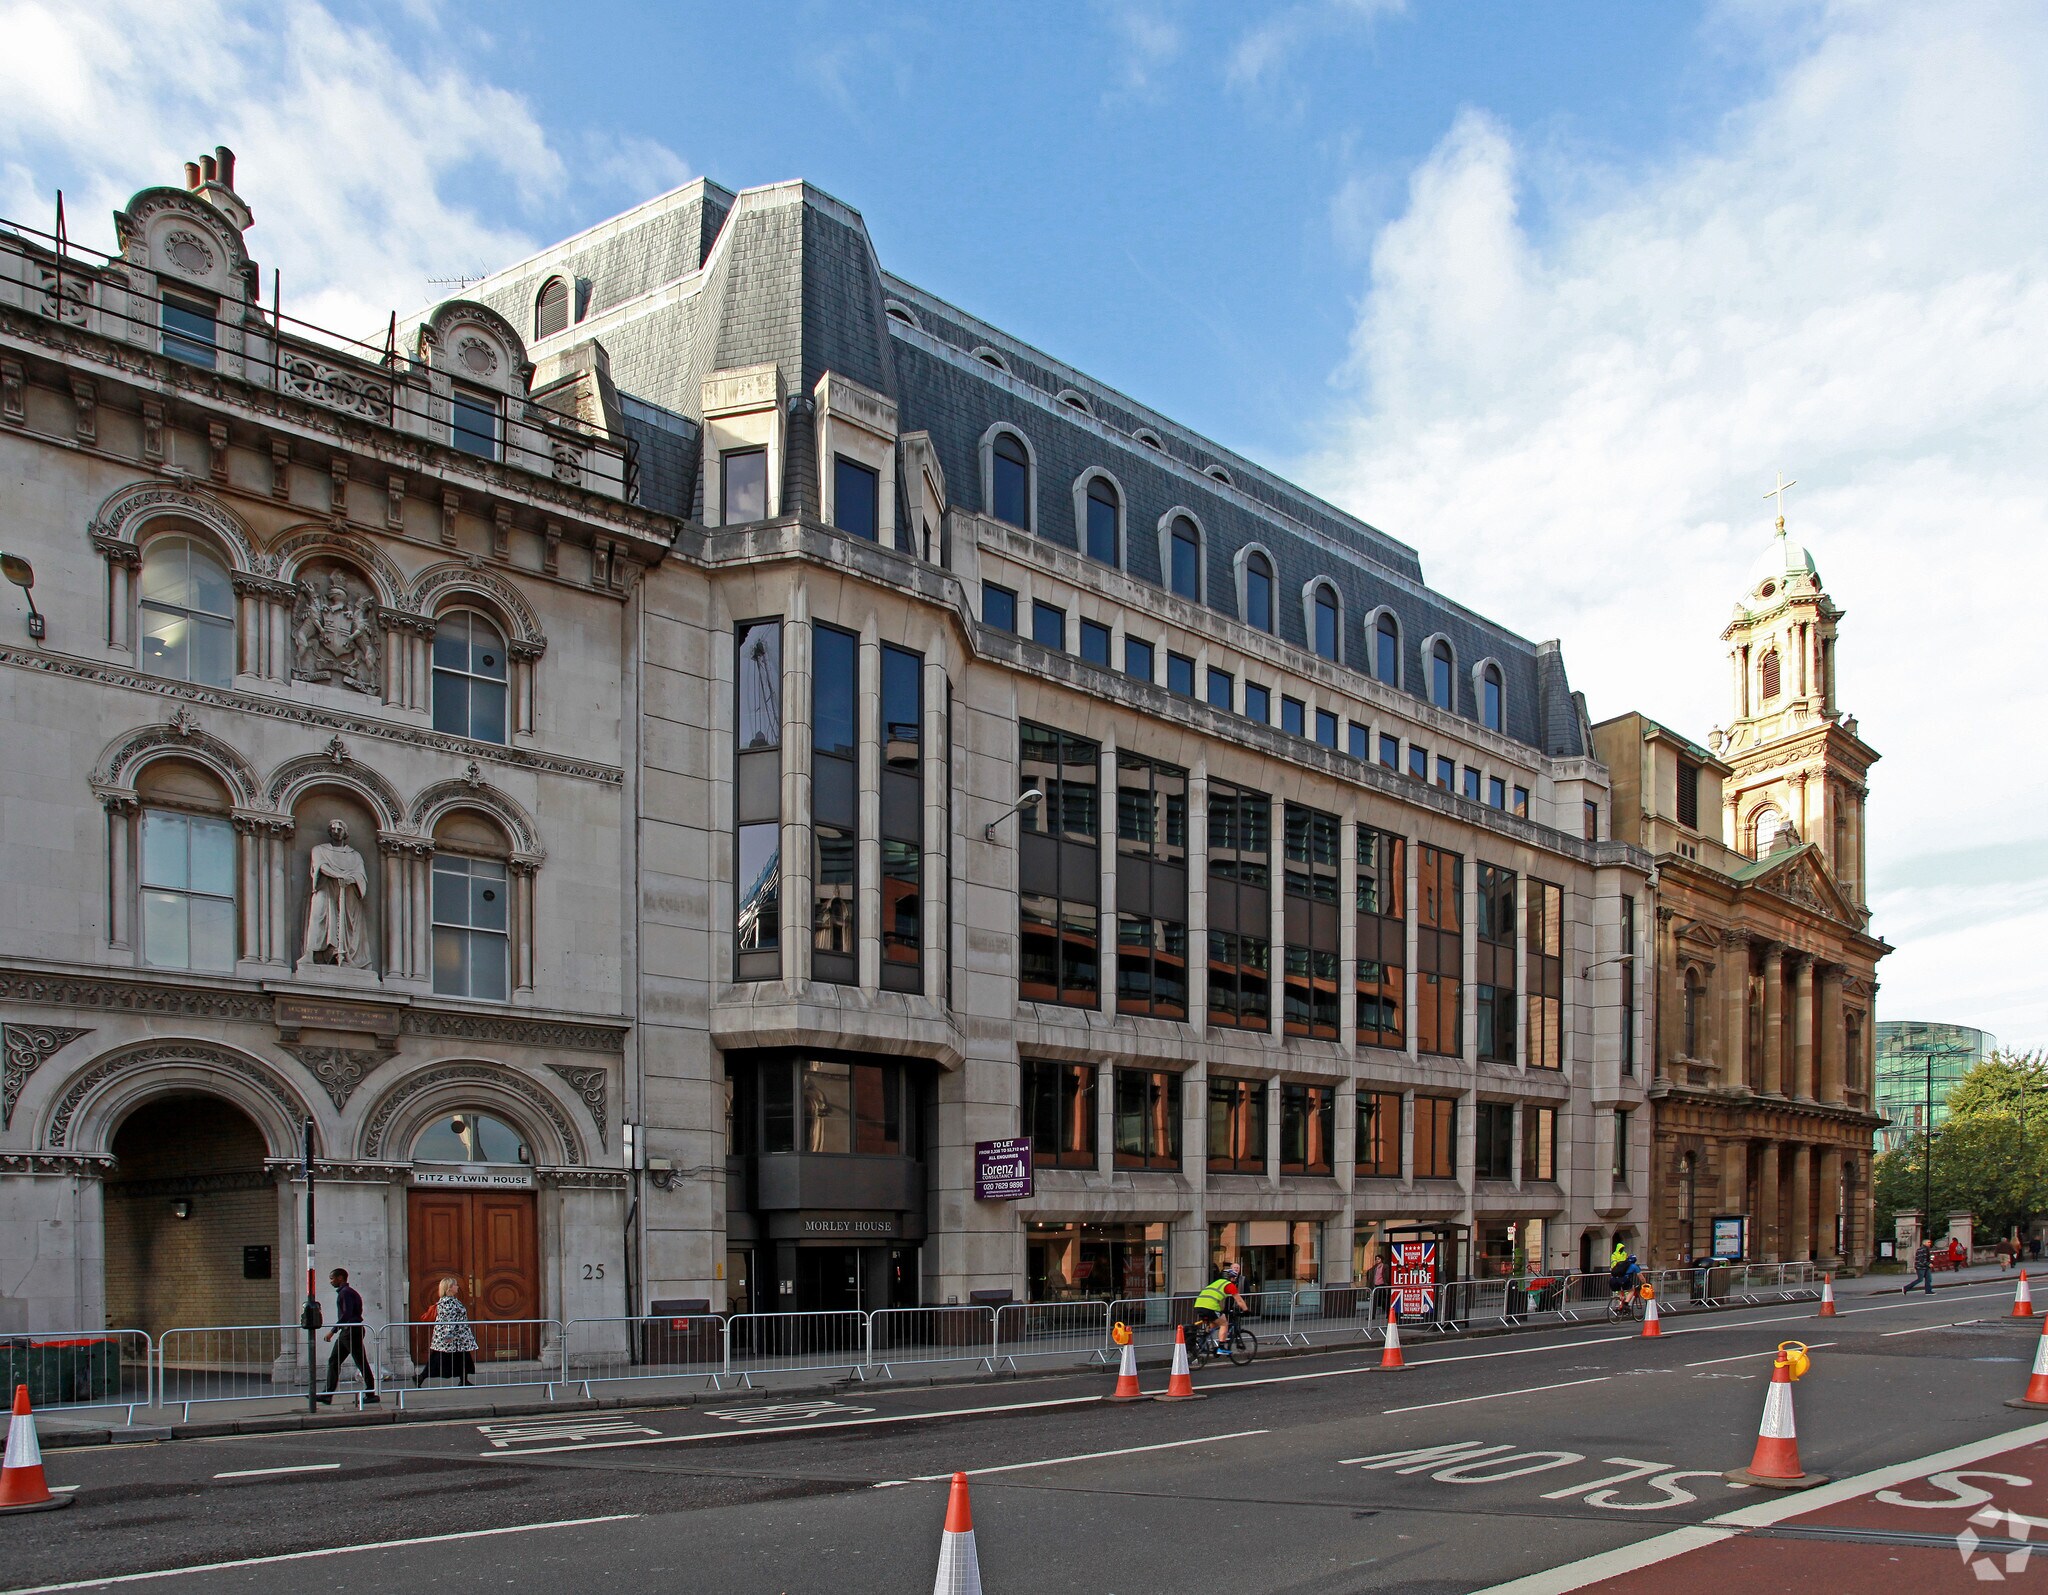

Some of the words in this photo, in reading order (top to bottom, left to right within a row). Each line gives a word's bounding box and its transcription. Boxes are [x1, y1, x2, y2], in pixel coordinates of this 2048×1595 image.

[982, 1164, 1014, 1176] Lorenz
[418, 1174, 443, 1182] FITZ
[448, 1175, 489, 1183] EYLWIN
[493, 1176, 527, 1184] HOUSE
[805, 1221, 850, 1231] MORLEY
[855, 1221, 892, 1231] HOUSE
[582, 1263, 605, 1280] 25
[1394, 1270, 1409, 1284] LET
[1410, 1270, 1418, 1284] IT
[1419, 1269, 1431, 1284] BE
[703, 1401, 876, 1423] BUS
[1338, 1441, 1752, 1510] SLOW
